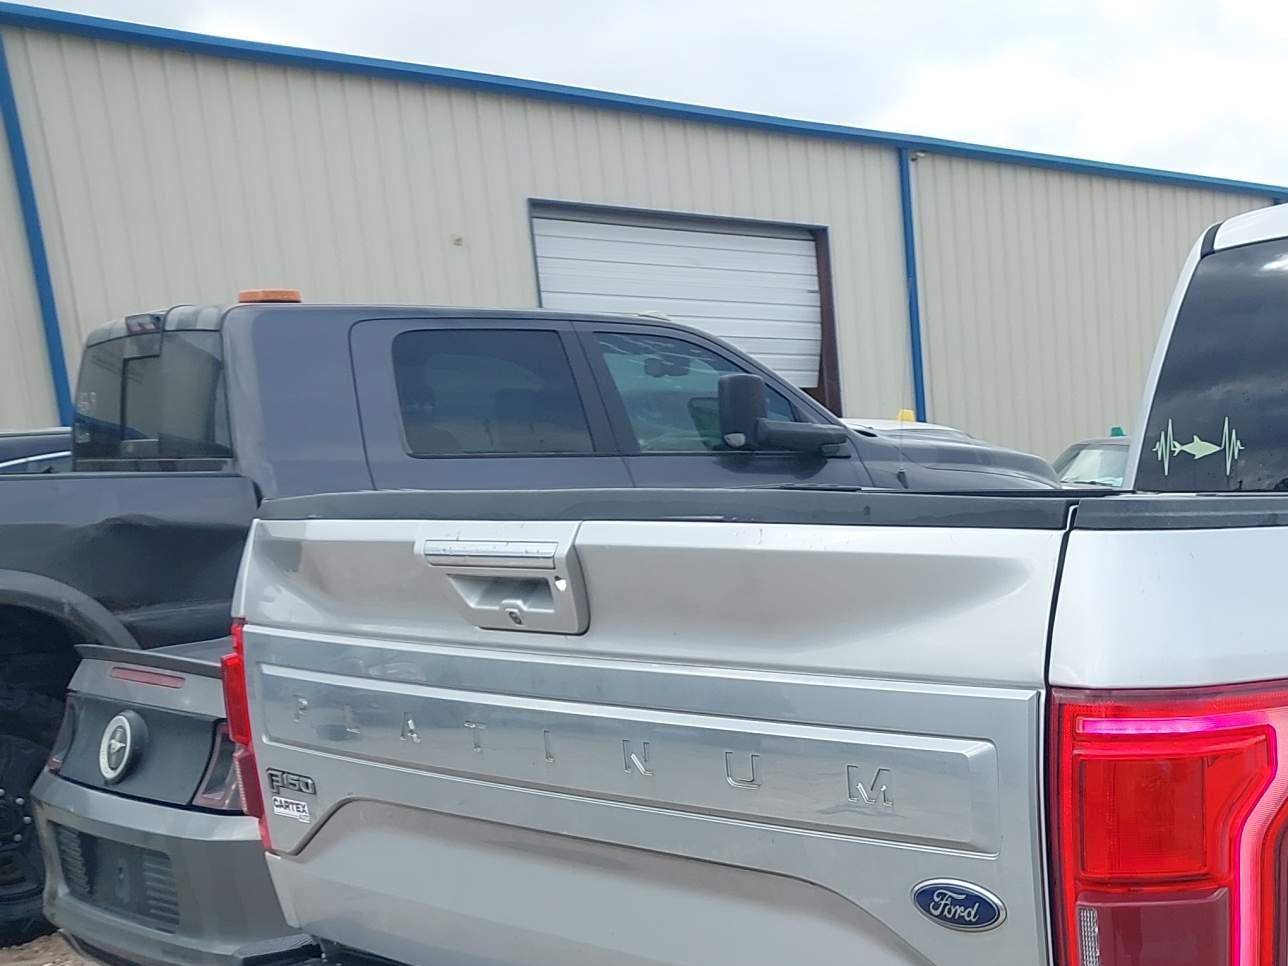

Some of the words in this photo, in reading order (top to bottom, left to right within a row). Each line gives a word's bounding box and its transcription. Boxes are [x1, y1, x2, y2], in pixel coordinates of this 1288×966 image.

[292, 694, 894, 808] PLATINUM
[273, 798, 308, 814] CARTEX
[929, 888, 980, 922] Ford
